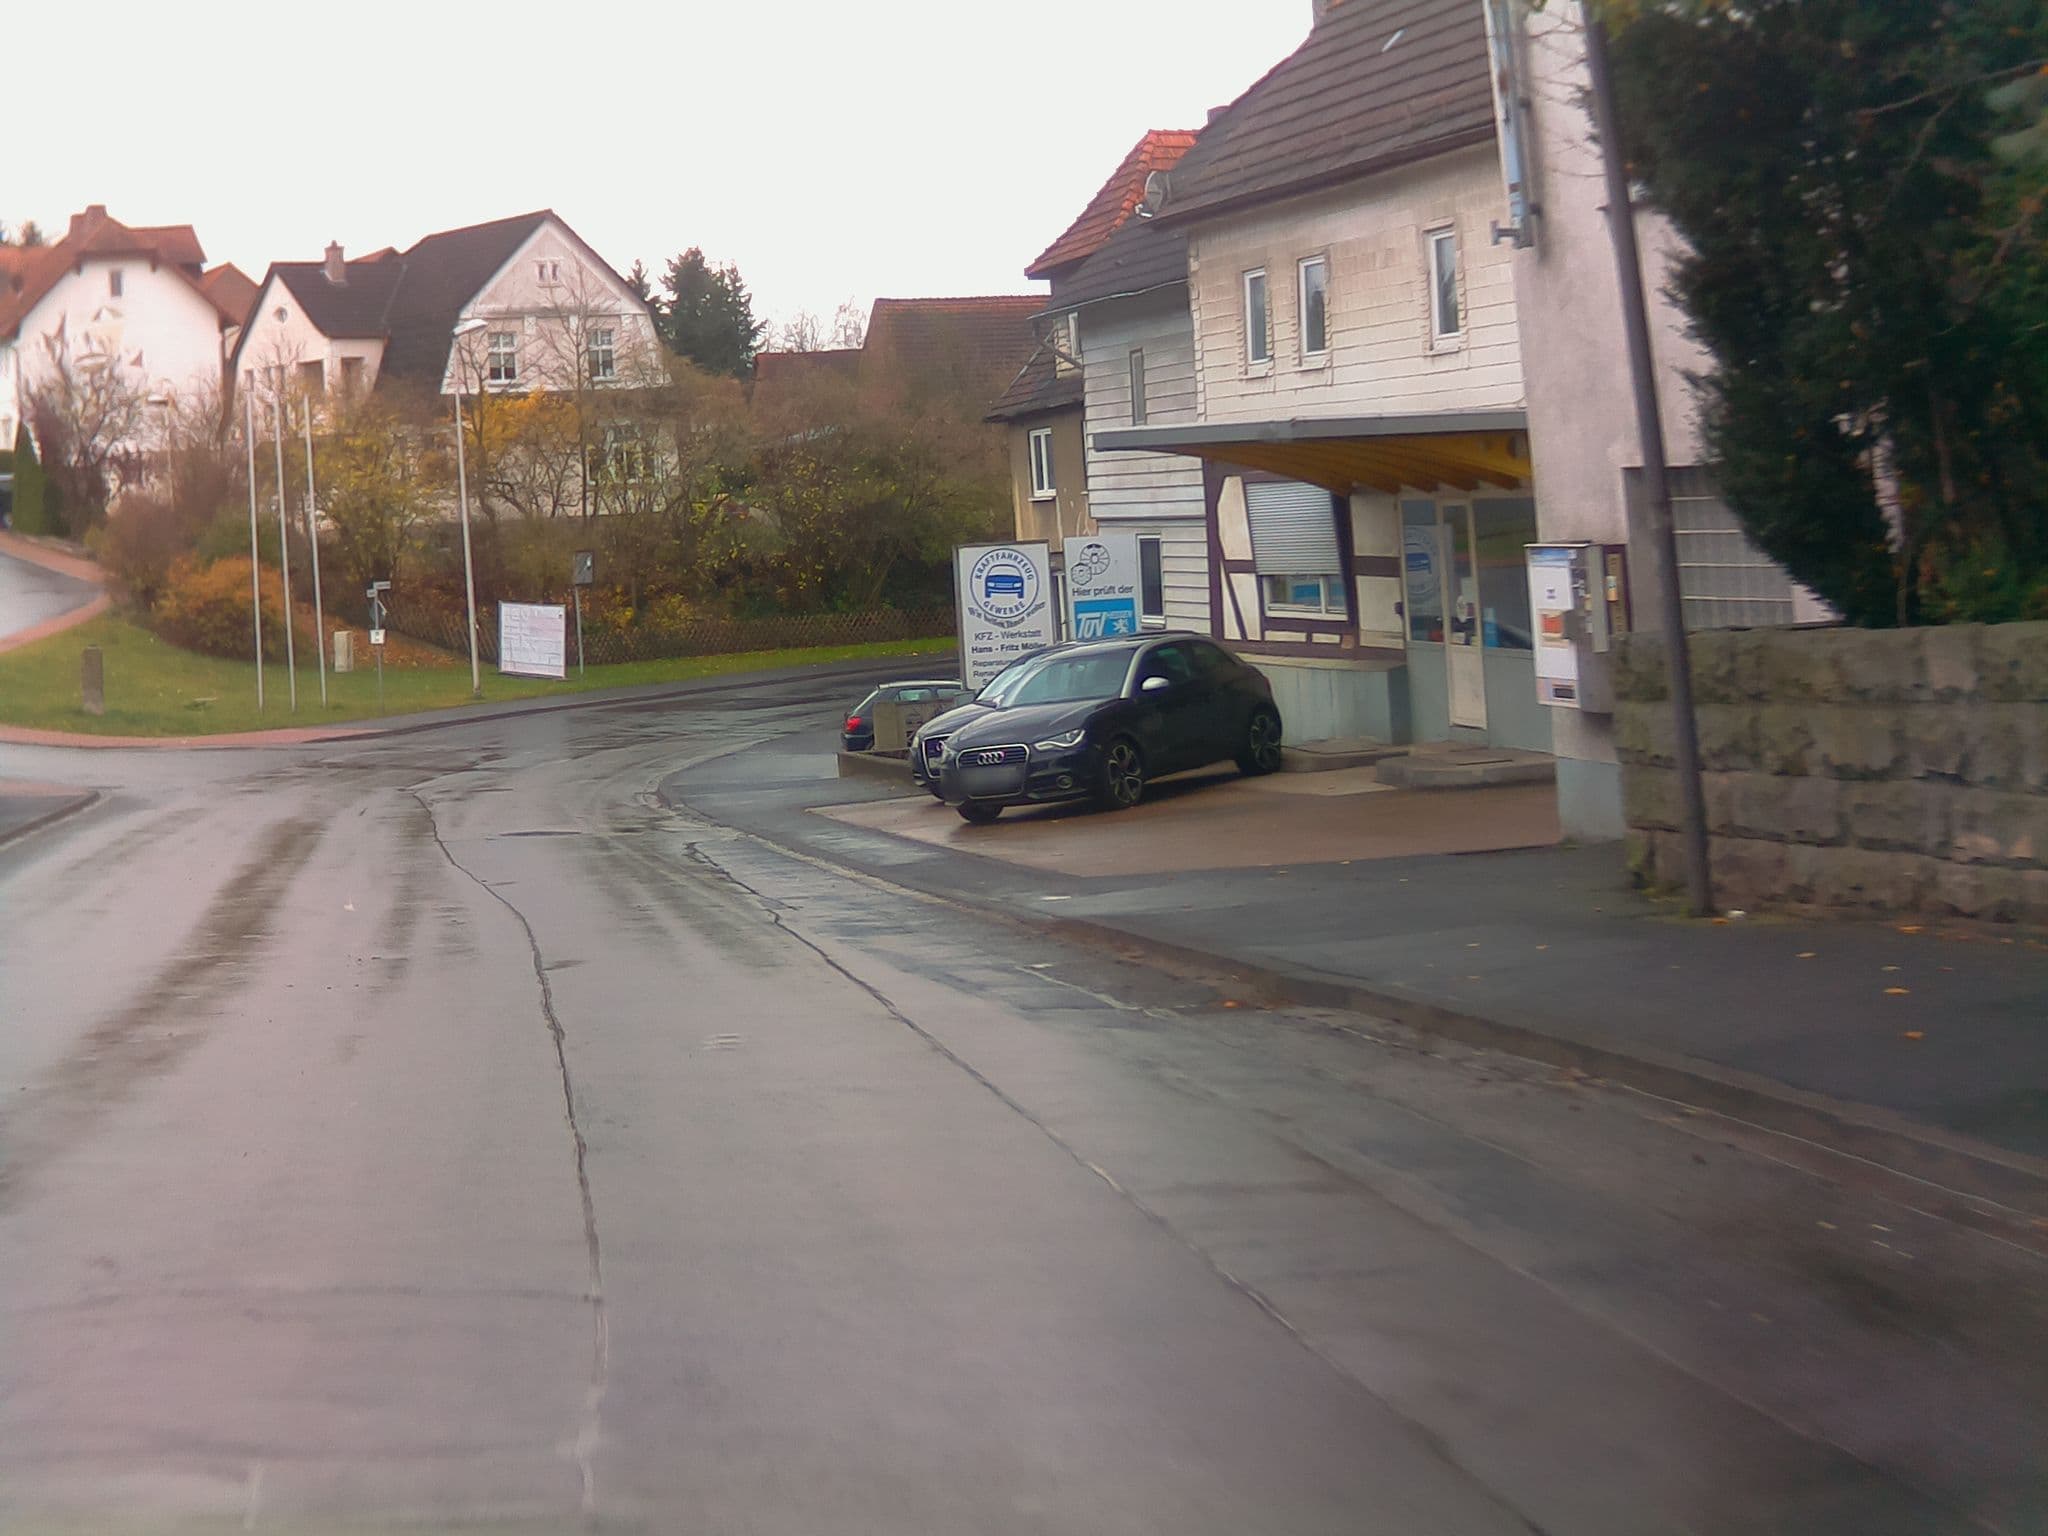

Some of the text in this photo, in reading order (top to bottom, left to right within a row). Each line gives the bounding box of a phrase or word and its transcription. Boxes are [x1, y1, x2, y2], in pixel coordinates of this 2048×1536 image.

[975, 552, 1034, 580] KRAFTFAHRZEUG
[1072, 585, 1134, 597] Hier prüft der
[983, 600, 1025, 614] GEWERBE
[974, 631, 993, 641] KFZ
[1000, 629, 1042, 640] Werkstatt
[971, 646, 993, 654] Hans
[1000, 643, 1019, 652] Fritz
